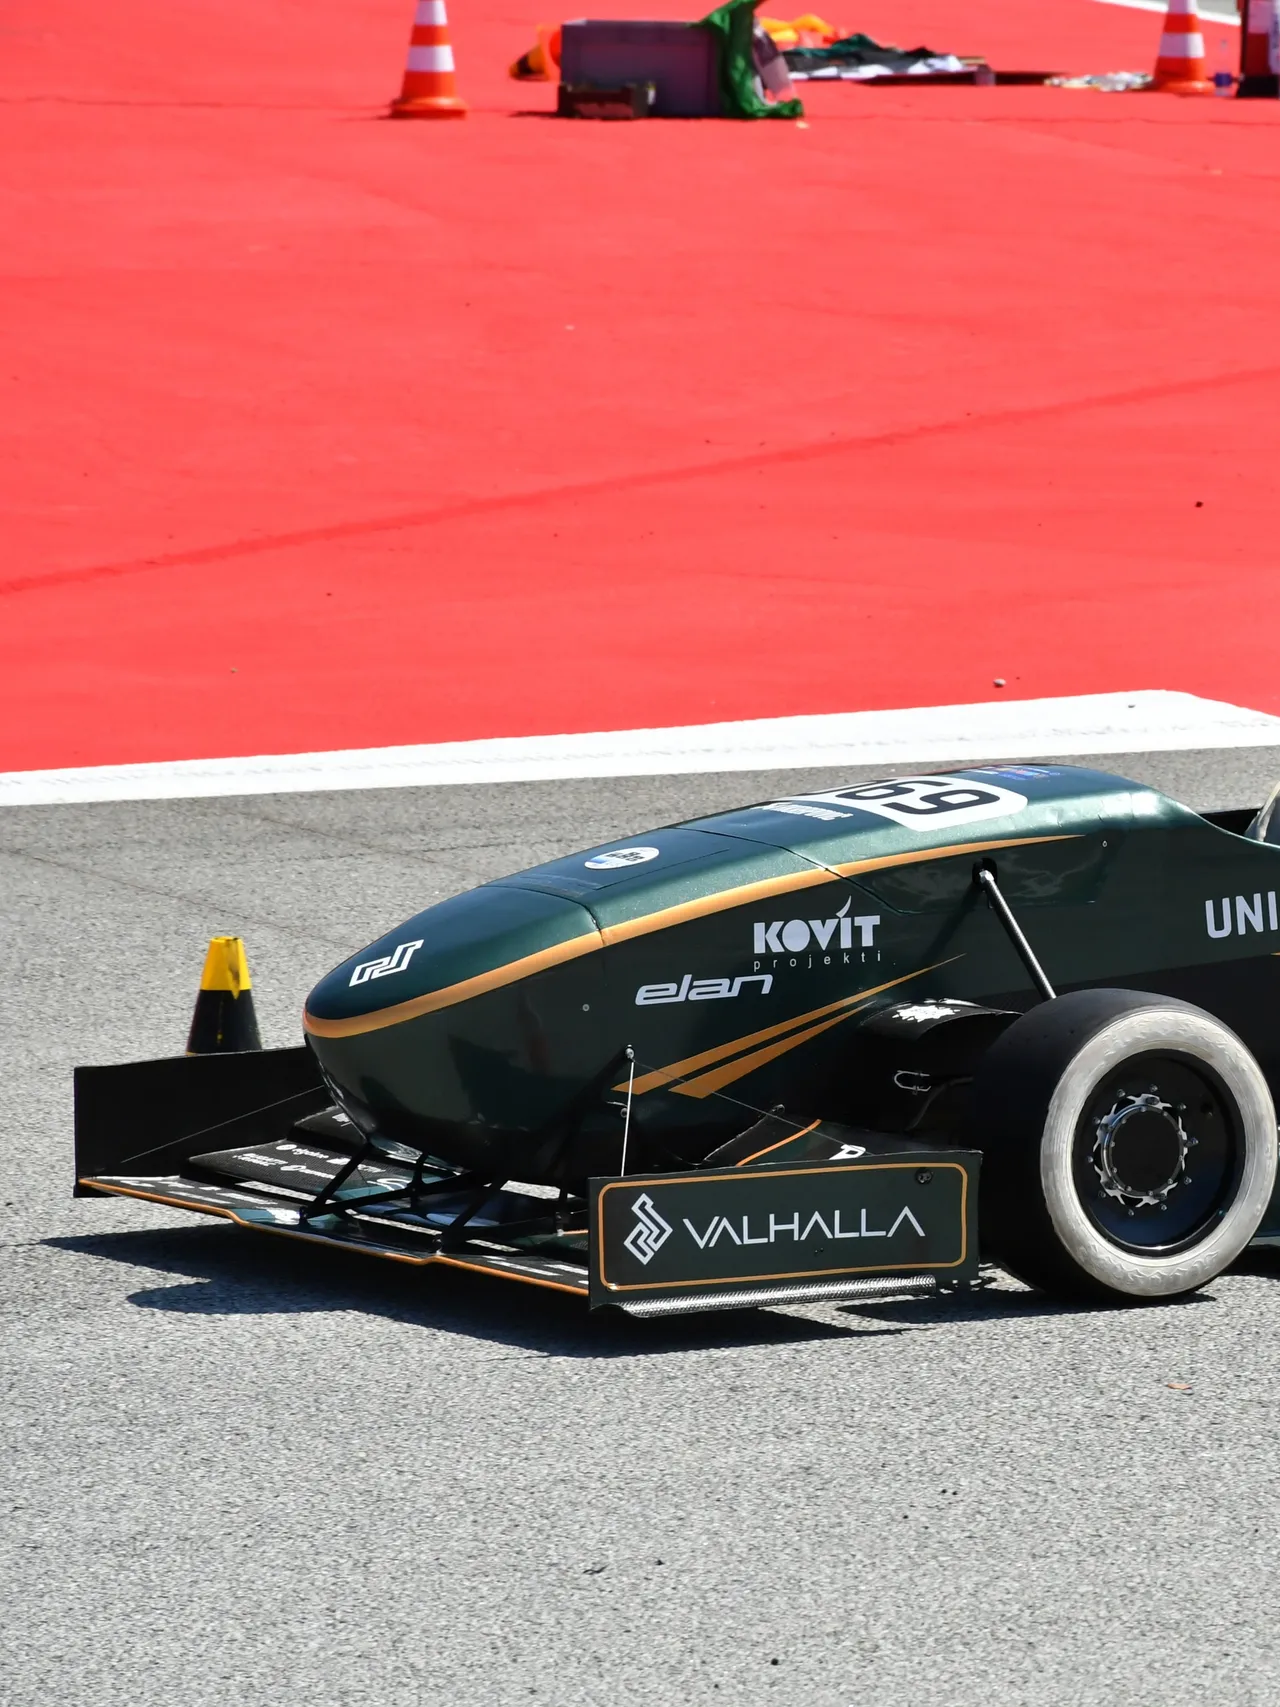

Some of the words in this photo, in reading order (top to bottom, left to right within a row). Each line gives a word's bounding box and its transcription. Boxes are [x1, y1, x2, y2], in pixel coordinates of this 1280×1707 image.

[1205, 891, 1279, 939] UNI
[753, 950, 881, 972] projekti
[635, 973, 774, 1006] elan
[682, 1205, 926, 1249] VALHALLA
